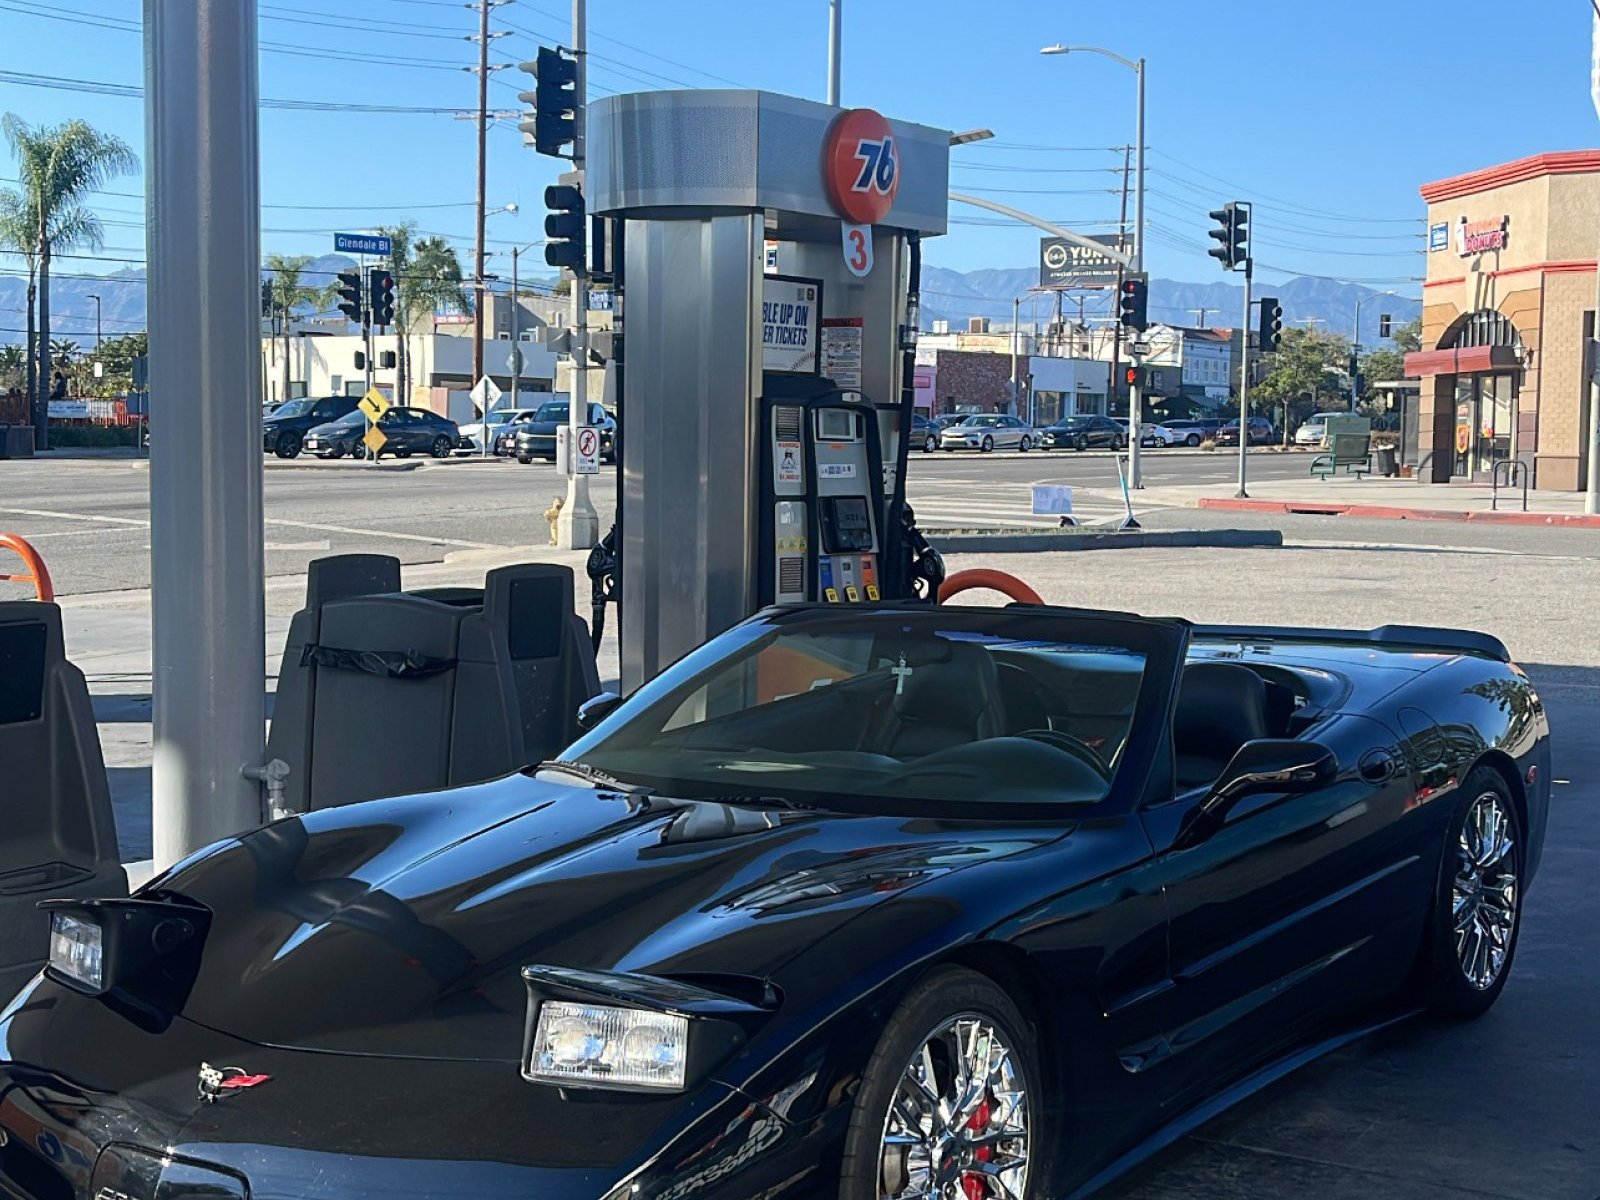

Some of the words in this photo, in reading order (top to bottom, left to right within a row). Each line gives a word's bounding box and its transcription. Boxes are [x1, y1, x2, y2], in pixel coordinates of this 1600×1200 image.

[852, 137, 896, 195] 76
[338, 237, 377, 250] Glendale
[379, 240, 389, 251] Bl
[849, 230, 867, 271] 3
[780, 303, 793, 325] UP
[795, 305, 809, 326] ON
[775, 326, 808, 346] TICKETS
